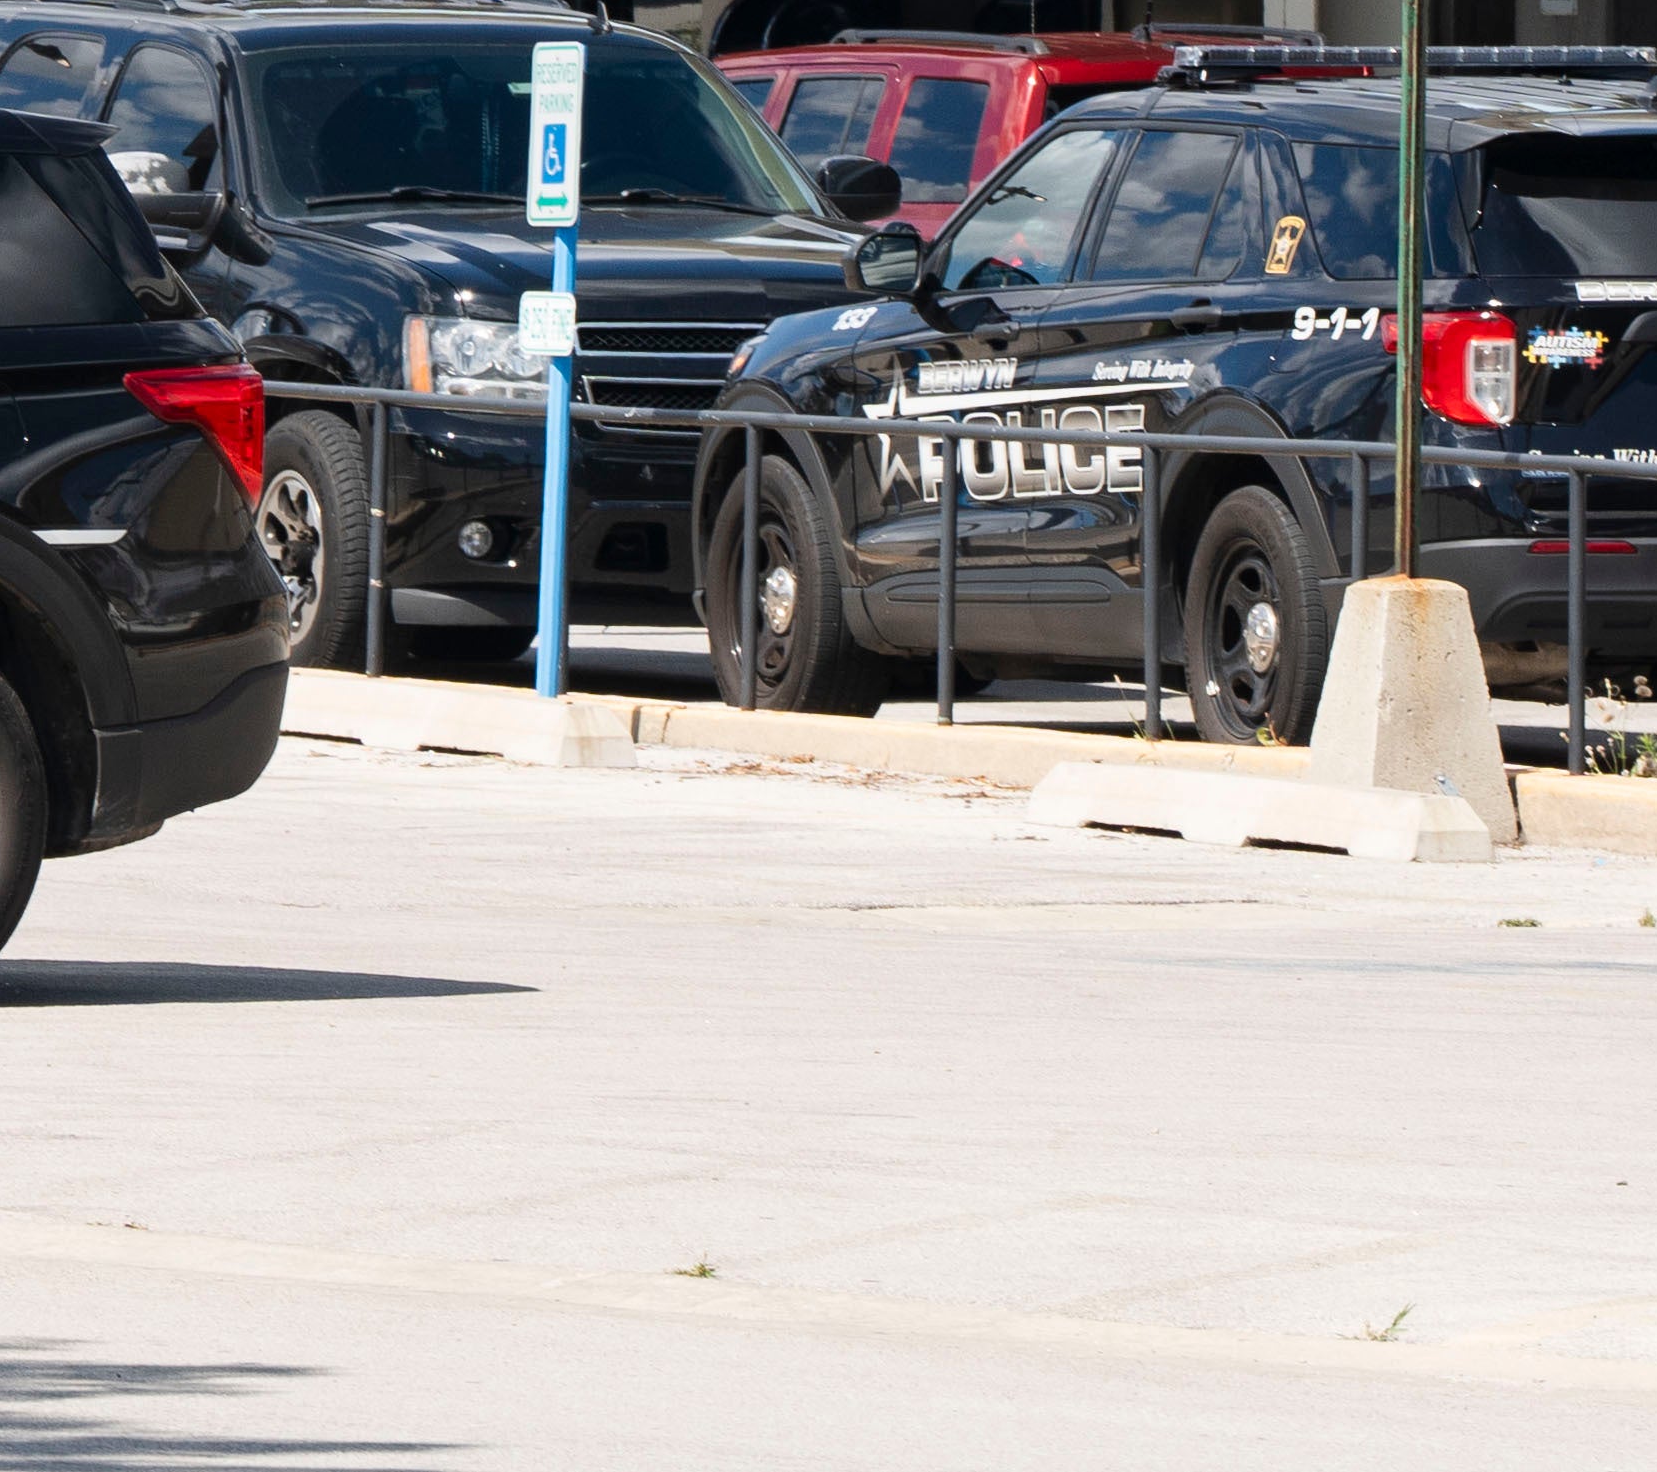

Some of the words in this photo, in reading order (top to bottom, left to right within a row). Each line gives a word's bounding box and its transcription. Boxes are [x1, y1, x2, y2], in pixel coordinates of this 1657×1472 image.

[535, 62, 579, 84] RESERVED
[539, 93, 574, 113] PARKING
[832, 306, 878, 331] 133
[1291, 306, 1381, 342] 9-1-1
[1534, 334, 1598, 350] AUTISM
[918, 357, 1018, 395] BERWYN
[1091, 360, 1129, 383] Serving
[1130, 359, 1151, 380] With
[1151, 357, 1195, 382] Integrity
[917, 403, 1146, 503] POLICE
